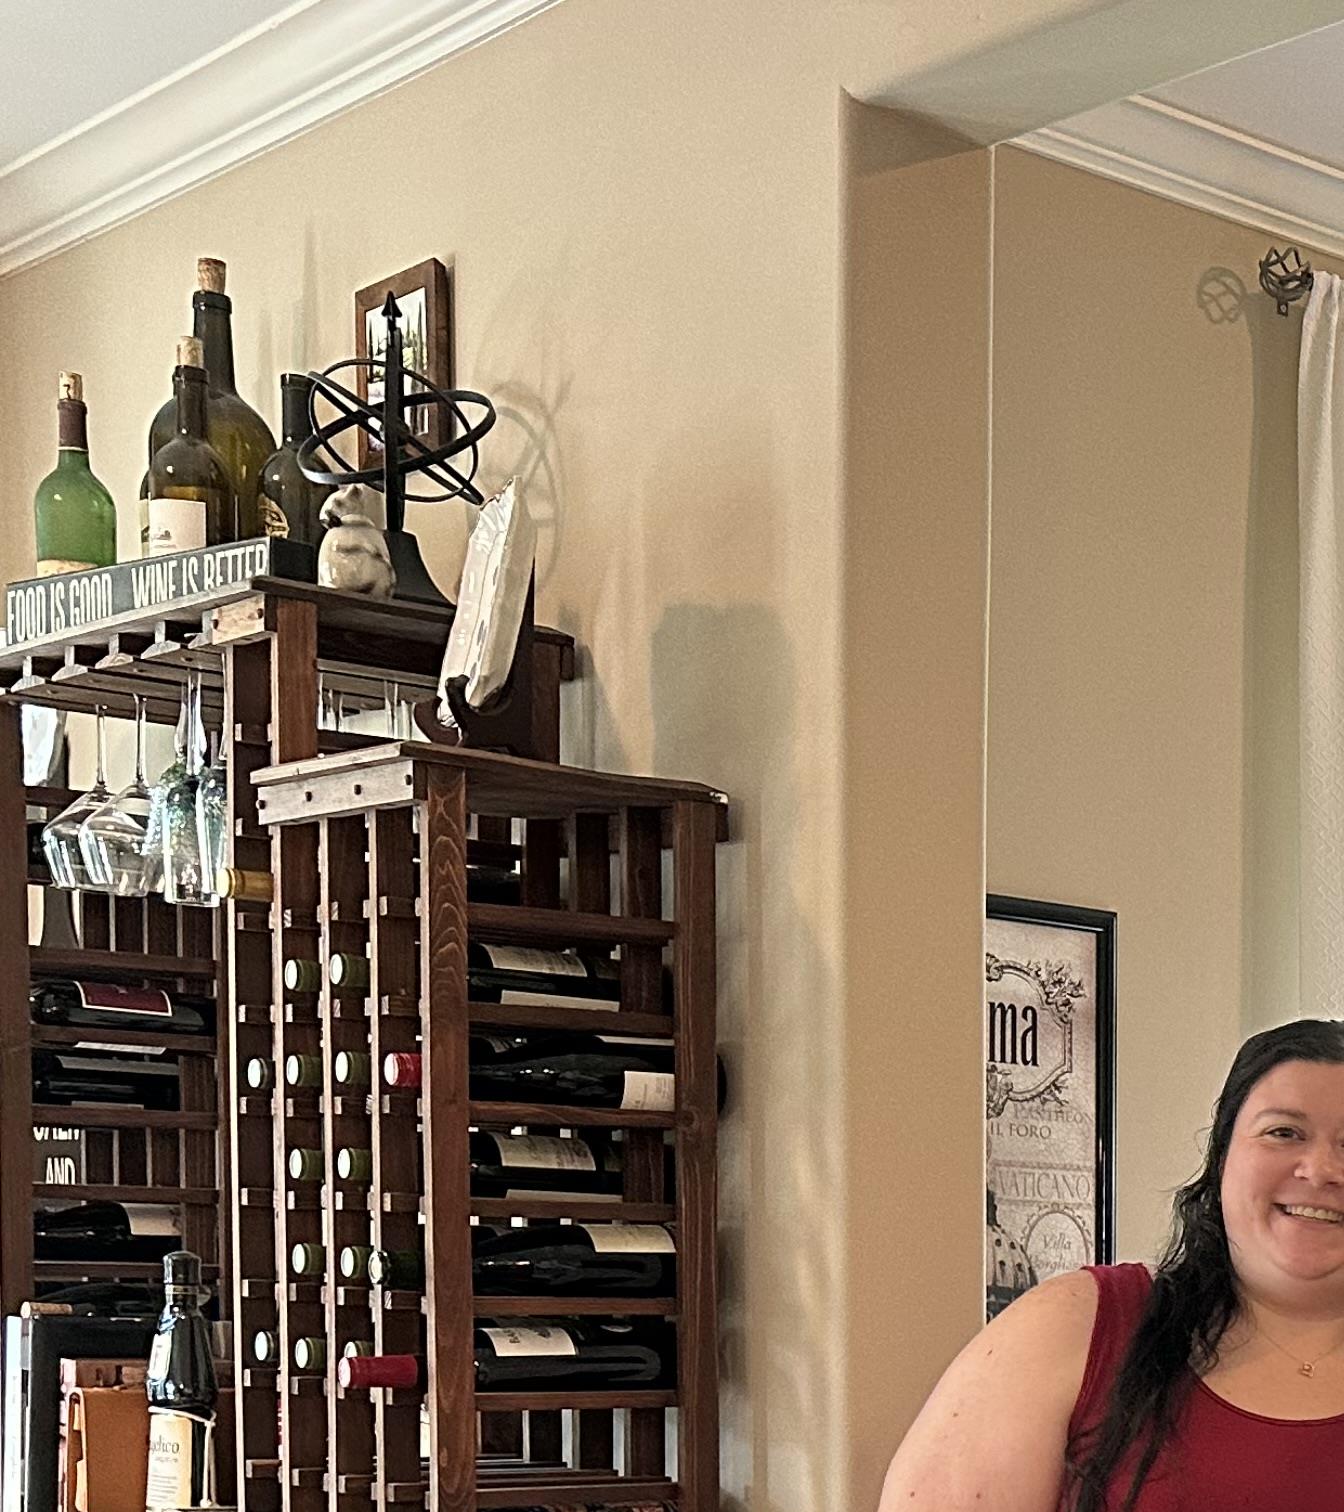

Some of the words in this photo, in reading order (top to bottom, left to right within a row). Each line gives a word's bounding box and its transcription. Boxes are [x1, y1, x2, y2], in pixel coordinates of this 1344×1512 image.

[7, 584, 46, 644] FOOD
[50, 582, 65, 634] IS
[68, 573, 113, 628] GOOD
[131, 559, 178, 609] WINE
[182, 556, 199, 596] IS
[204, 543, 267, 591] BETTER
[1009, 1123, 1052, 1139] FORO
[45, 1157, 76, 1185] AND
[998, 1171, 1091, 1200] VATICANO
[1043, 1232, 1071, 1250] Villa
